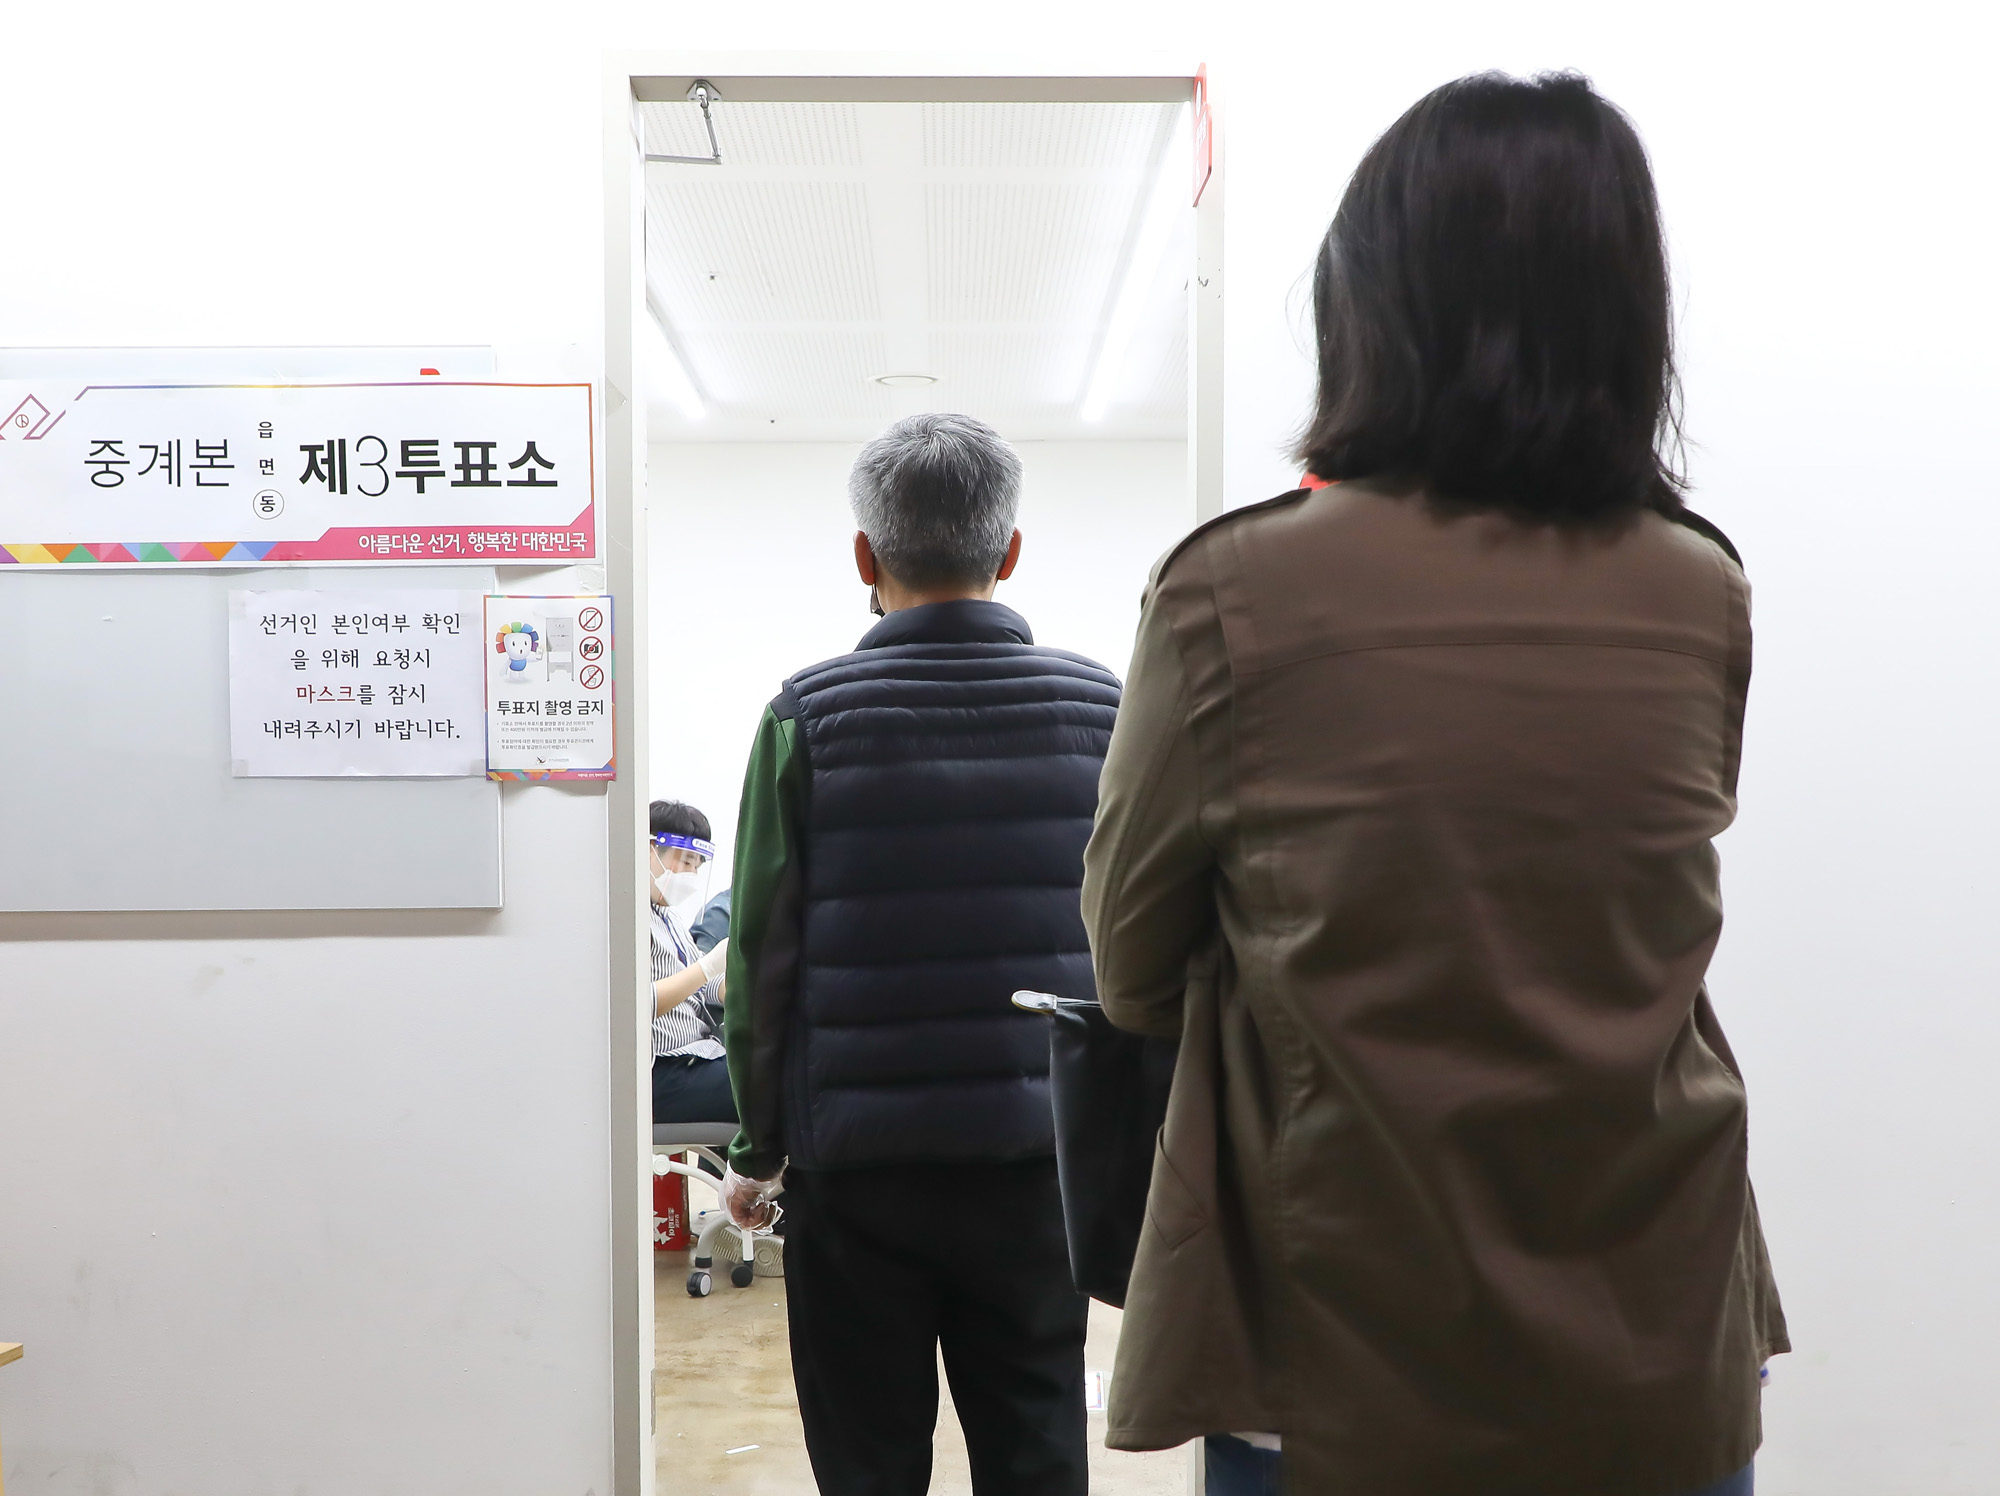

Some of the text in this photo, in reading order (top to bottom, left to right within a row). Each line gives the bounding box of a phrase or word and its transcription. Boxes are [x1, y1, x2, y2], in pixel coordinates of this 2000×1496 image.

[84, 435, 558, 497] 중계본 제3투표소
[258, 422, 277, 513] 읍 면 동
[359, 531, 588, 556] 아름다운 선거, 행복한 대한민국
[260, 613, 459, 635] 선거인 본인여부 확인
[291, 649, 429, 670] 을 위해 요청시
[296, 684, 424, 705] 마스크를 잠시
[497, 700, 603, 715] 투표지 촬영 금지
[264, 719, 460, 740] 내려주시기 바랍니다.
